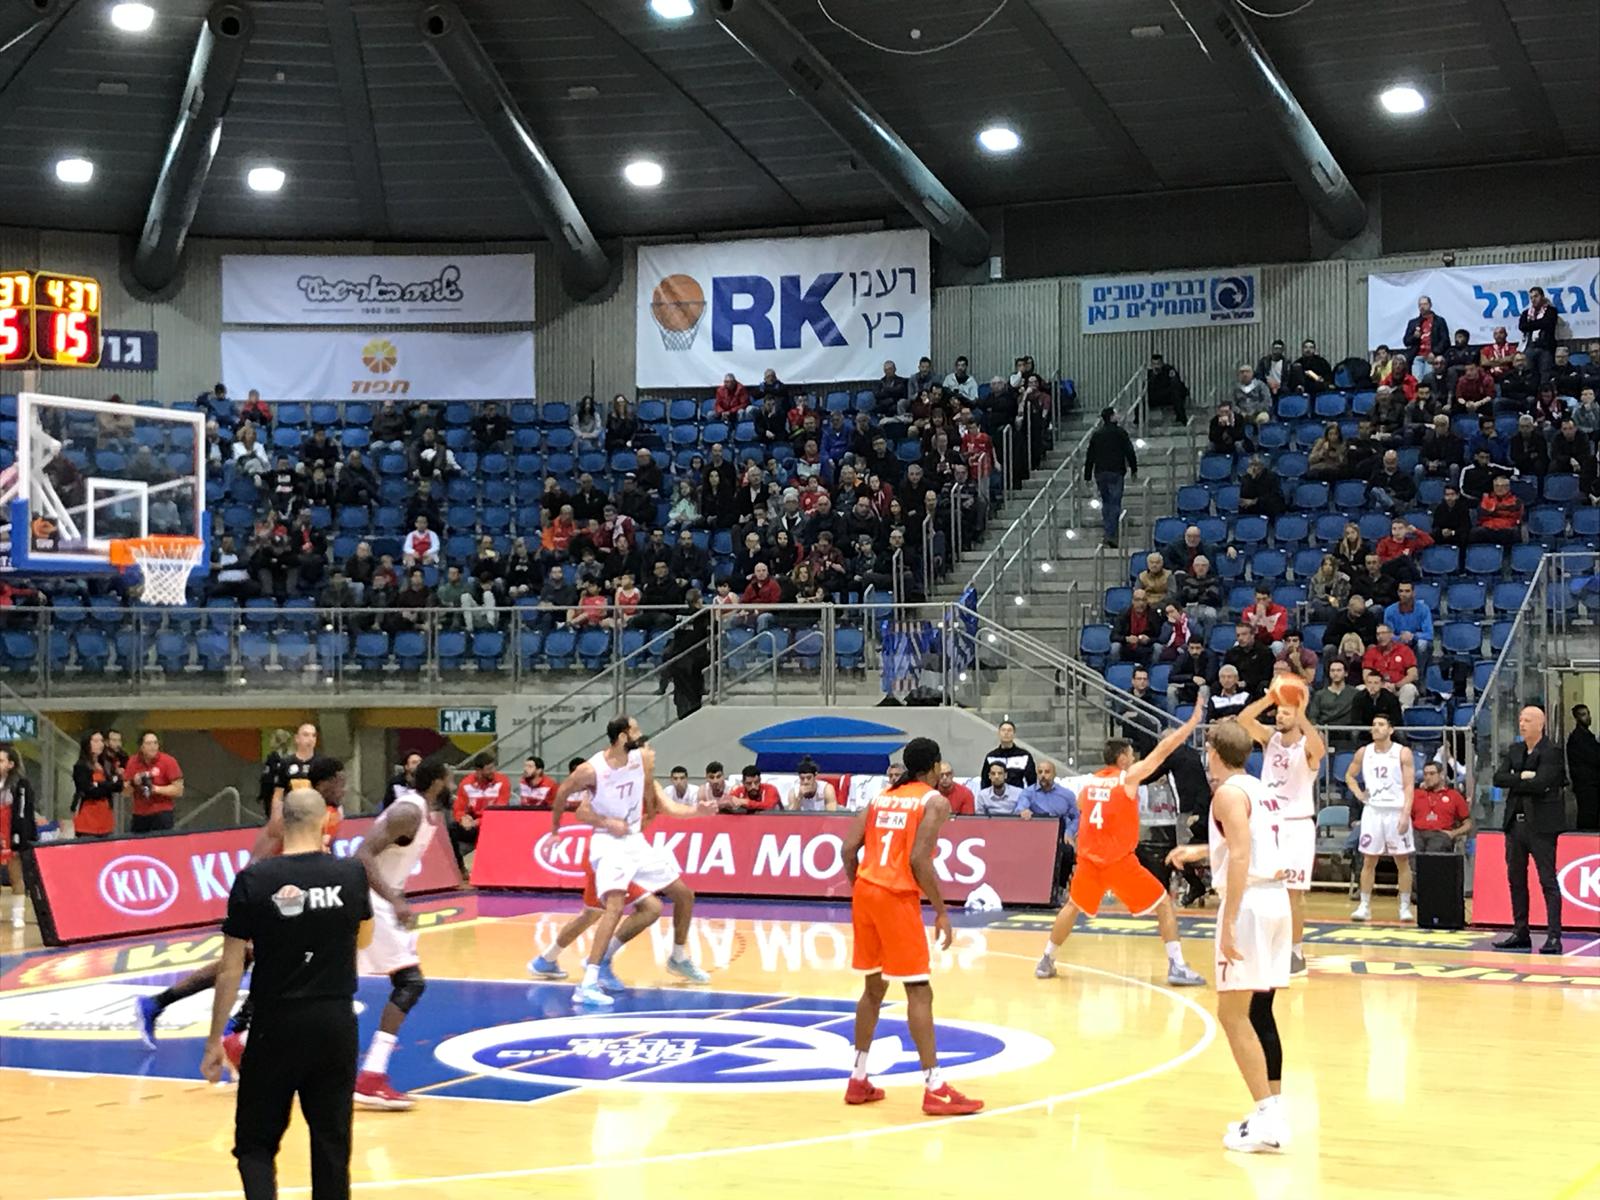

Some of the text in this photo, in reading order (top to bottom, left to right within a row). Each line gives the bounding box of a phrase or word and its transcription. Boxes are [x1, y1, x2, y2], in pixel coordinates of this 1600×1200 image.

[47, 279, 98, 312] 4:37
[850, 267, 916, 306] רענן
[1093, 278, 1206, 302] דברים טובים
[712, 272, 848, 351] RK
[1088, 296, 1207, 325] מתחילים כאן
[55, 312, 88, 358] 15
[862, 311, 904, 348] כץ
[100, 336, 142, 363] גו
[351, 380, 410, 394] תפוז
[1273, 753, 1289, 770] 24
[1374, 766, 1389, 779] 12
[616, 781, 634, 800] 77
[1089, 801, 1104, 829] 4
[549, 836, 587, 864] KI
[652, 832, 987, 884] KIA MORS
[880, 830, 894, 866] 1
[109, 866, 169, 903] KIA
[190, 848, 251, 900] KI
[309, 885, 344, 909] RK
[1217, 961, 1228, 982] 7
